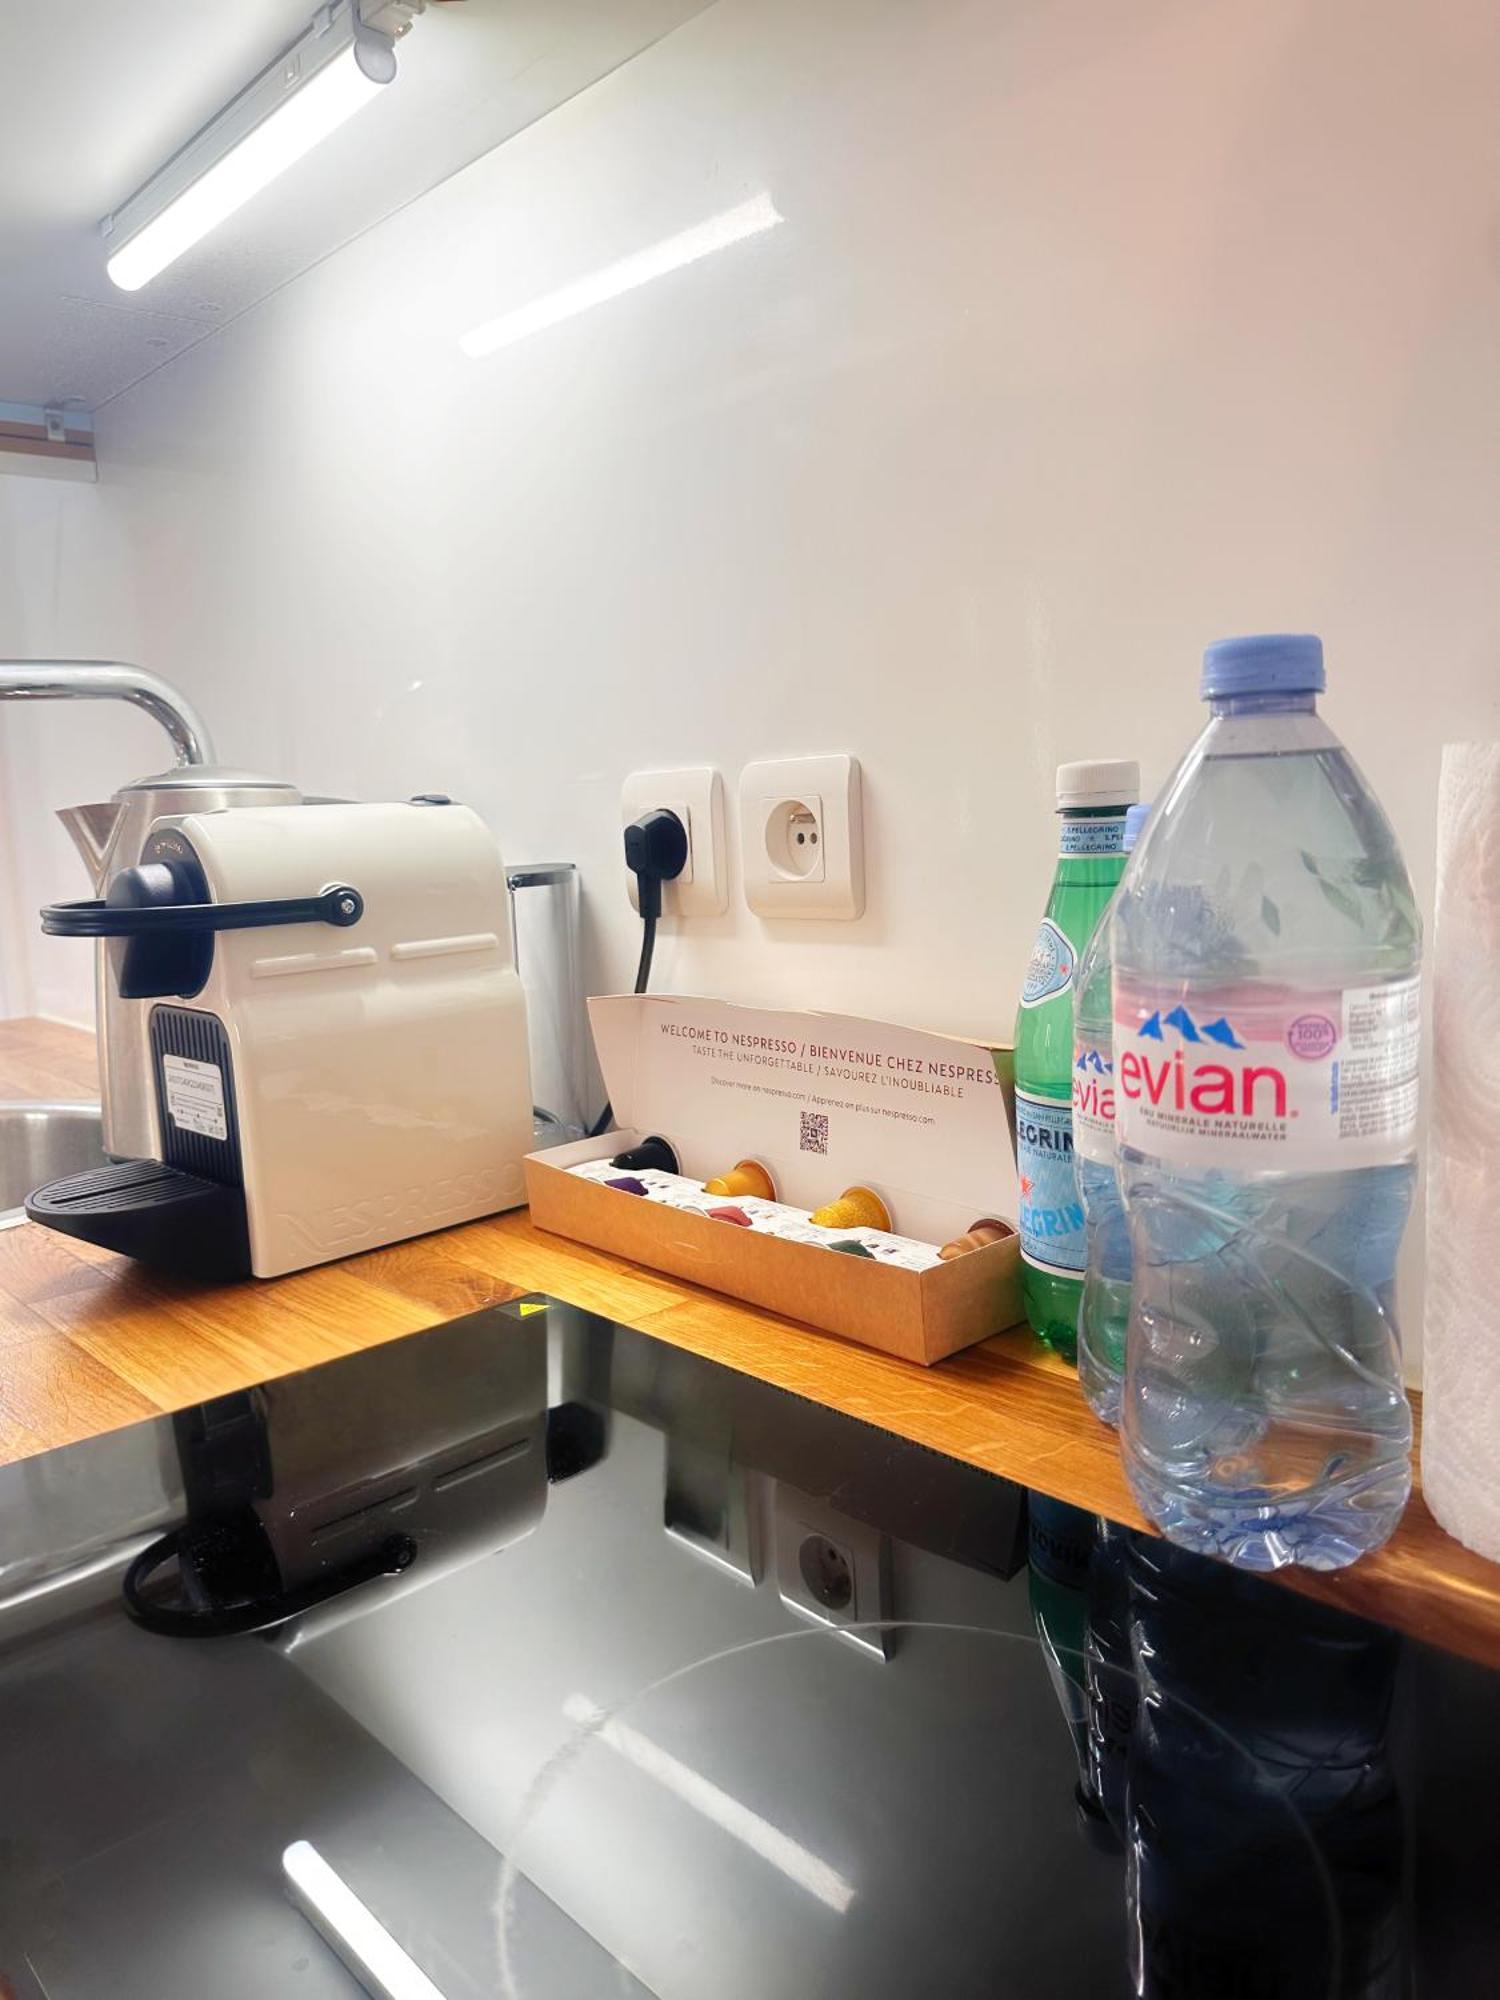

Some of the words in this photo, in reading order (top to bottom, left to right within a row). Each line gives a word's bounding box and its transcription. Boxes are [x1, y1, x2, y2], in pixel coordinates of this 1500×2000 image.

[661, 1024, 712, 1042] WELCOME
[715, 1031, 728, 1044] TO
[732, 1034, 796, 1054] NESPRESSO
[800, 1043, 806, 1058] /
[810, 1045, 882, 1067] BIENVENUE
[887, 1056, 923, 1073] CHEZ
[928, 1063, 999, 1085] NESPRESS
[692, 1045, 716, 1058] TASTE
[718, 1049, 733, 1061] THE
[736, 1053, 814, 1074] UNFORGETTABLE
[824, 1066, 877, 1084] SAVOUREZ
[881, 1075, 964, 1098] L'INOUBLIABLE
[1072, 1077, 1115, 1120] evia
